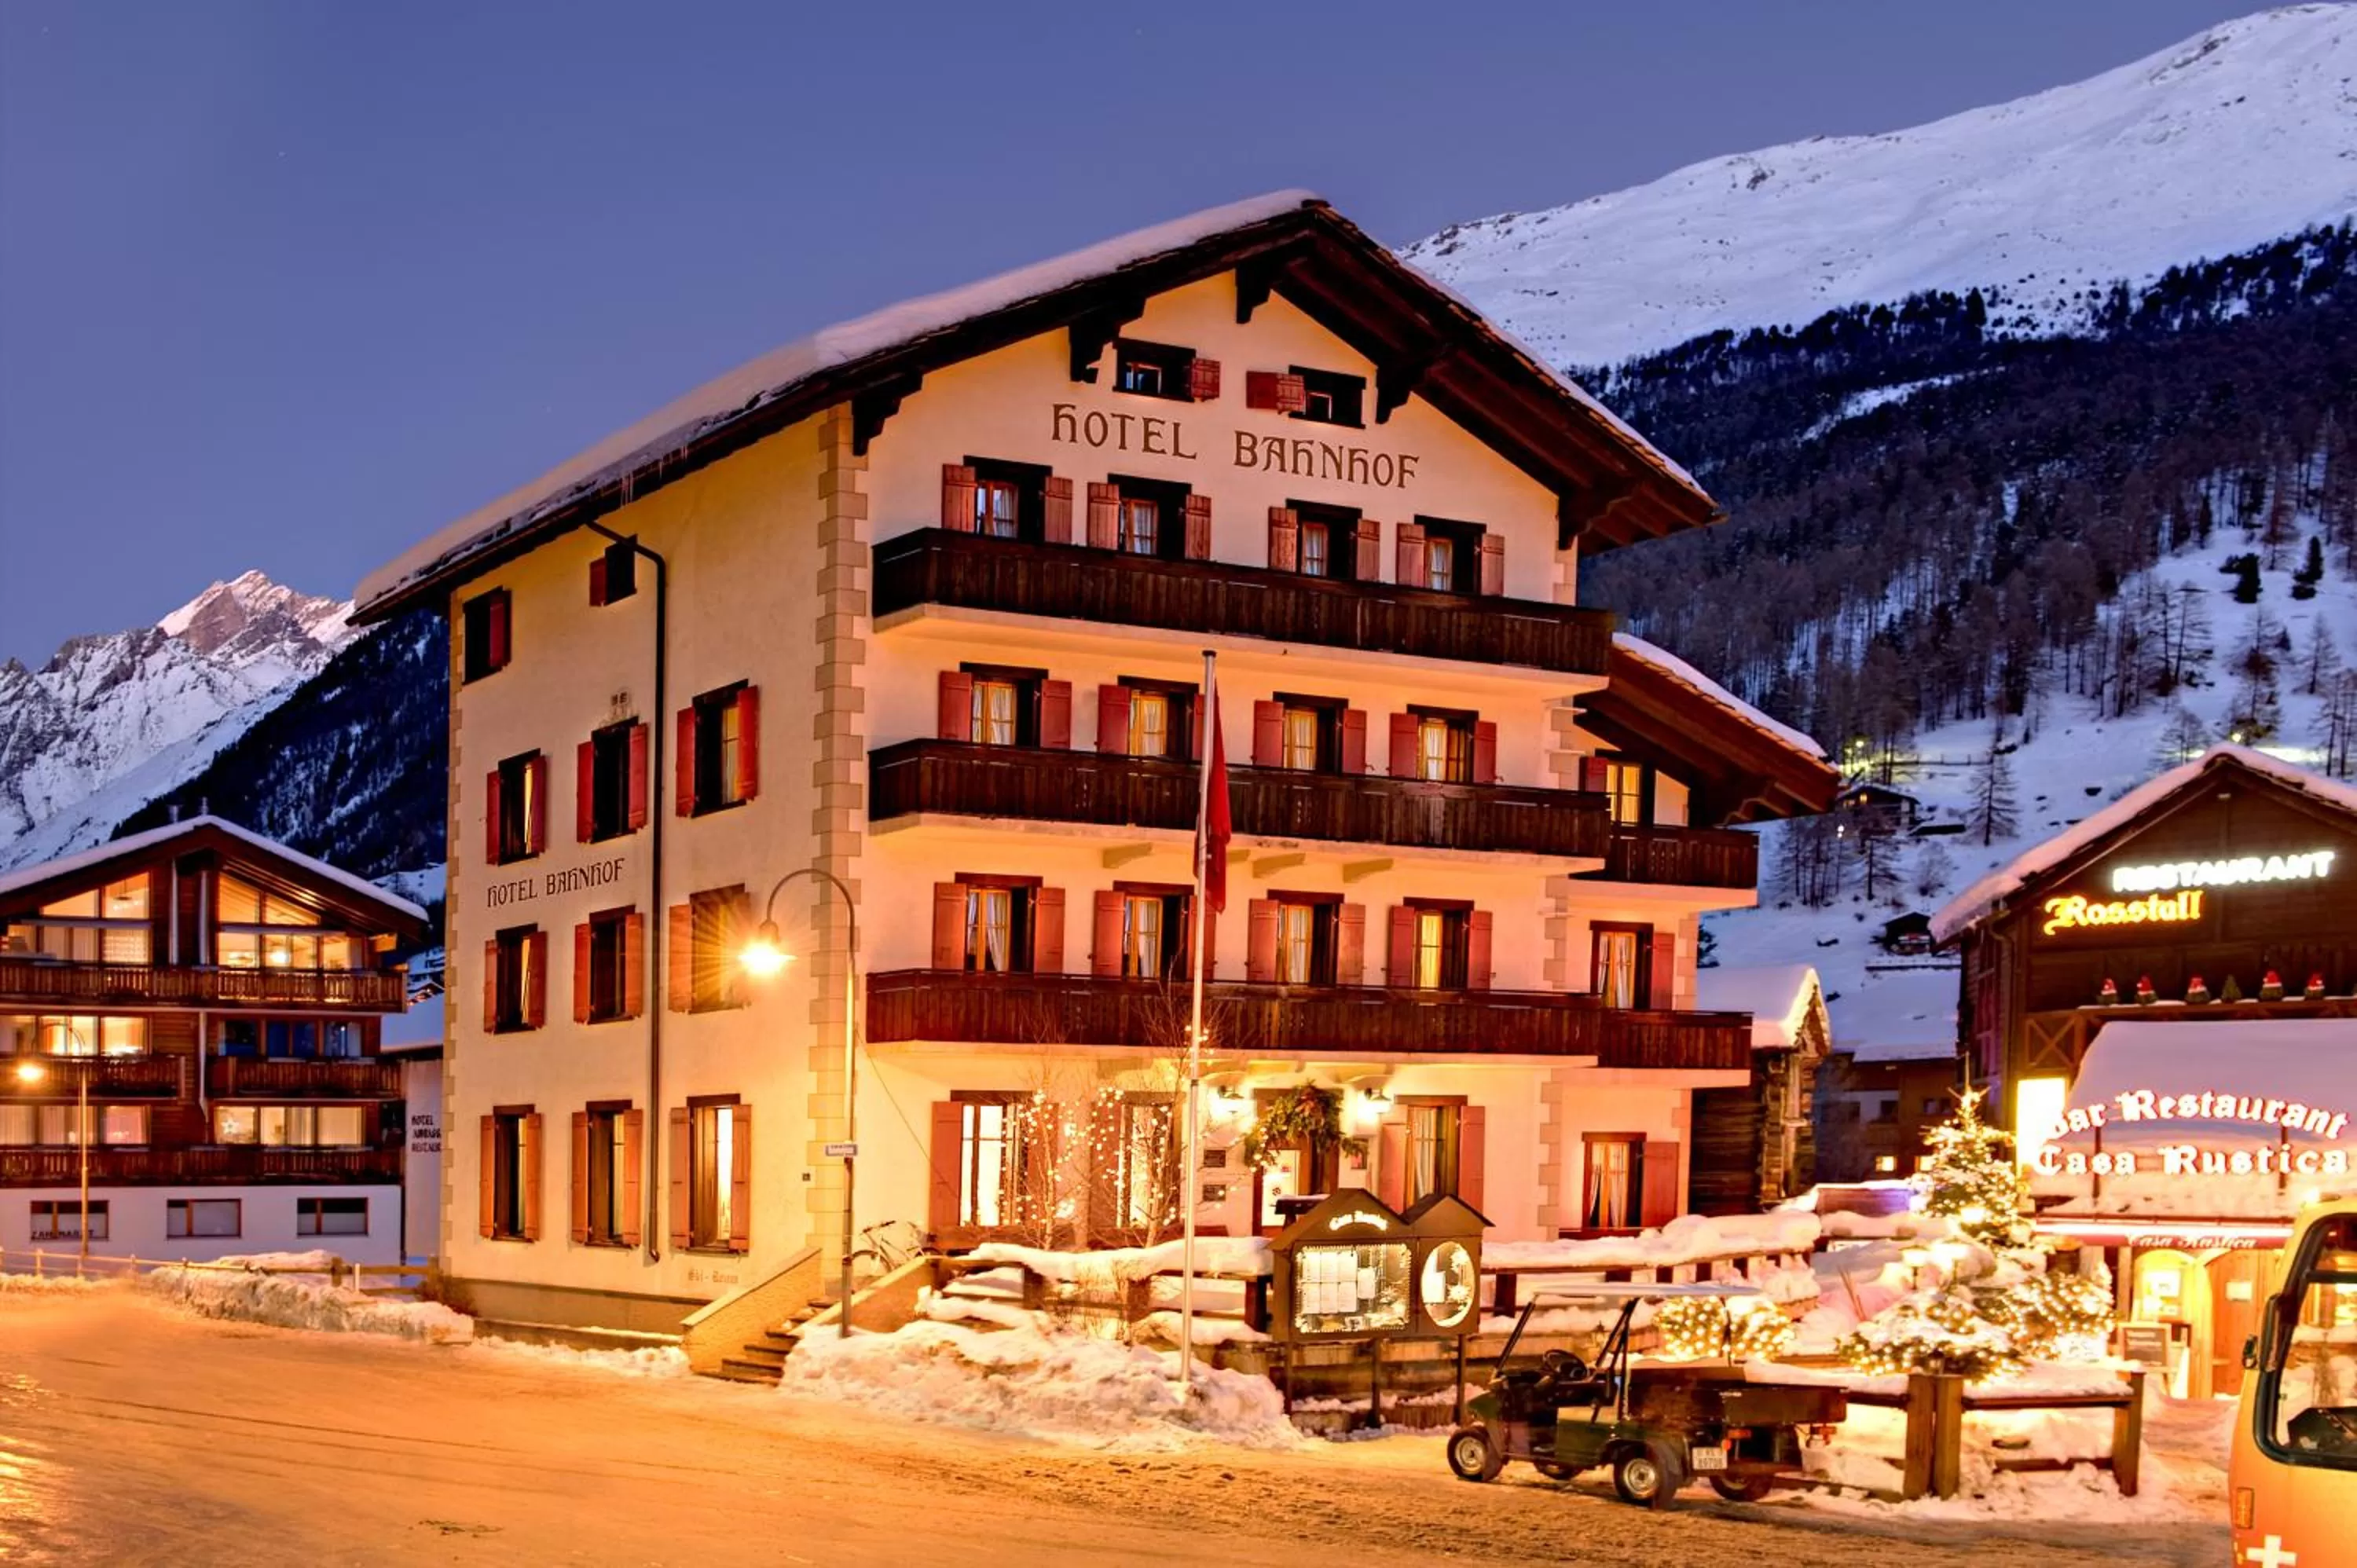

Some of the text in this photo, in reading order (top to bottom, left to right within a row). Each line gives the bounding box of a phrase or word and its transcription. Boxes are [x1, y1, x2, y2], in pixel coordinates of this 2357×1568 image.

[1052, 403, 1420, 488] HOTEL BAHNHOF
[487, 857, 625, 907] HOTEL BAHNHOF
[2044, 889, 2204, 936] Rosstall
[2114, 1089, 2349, 1140] Restaurant
[2032, 1142, 2349, 1176] Casa Rustica
